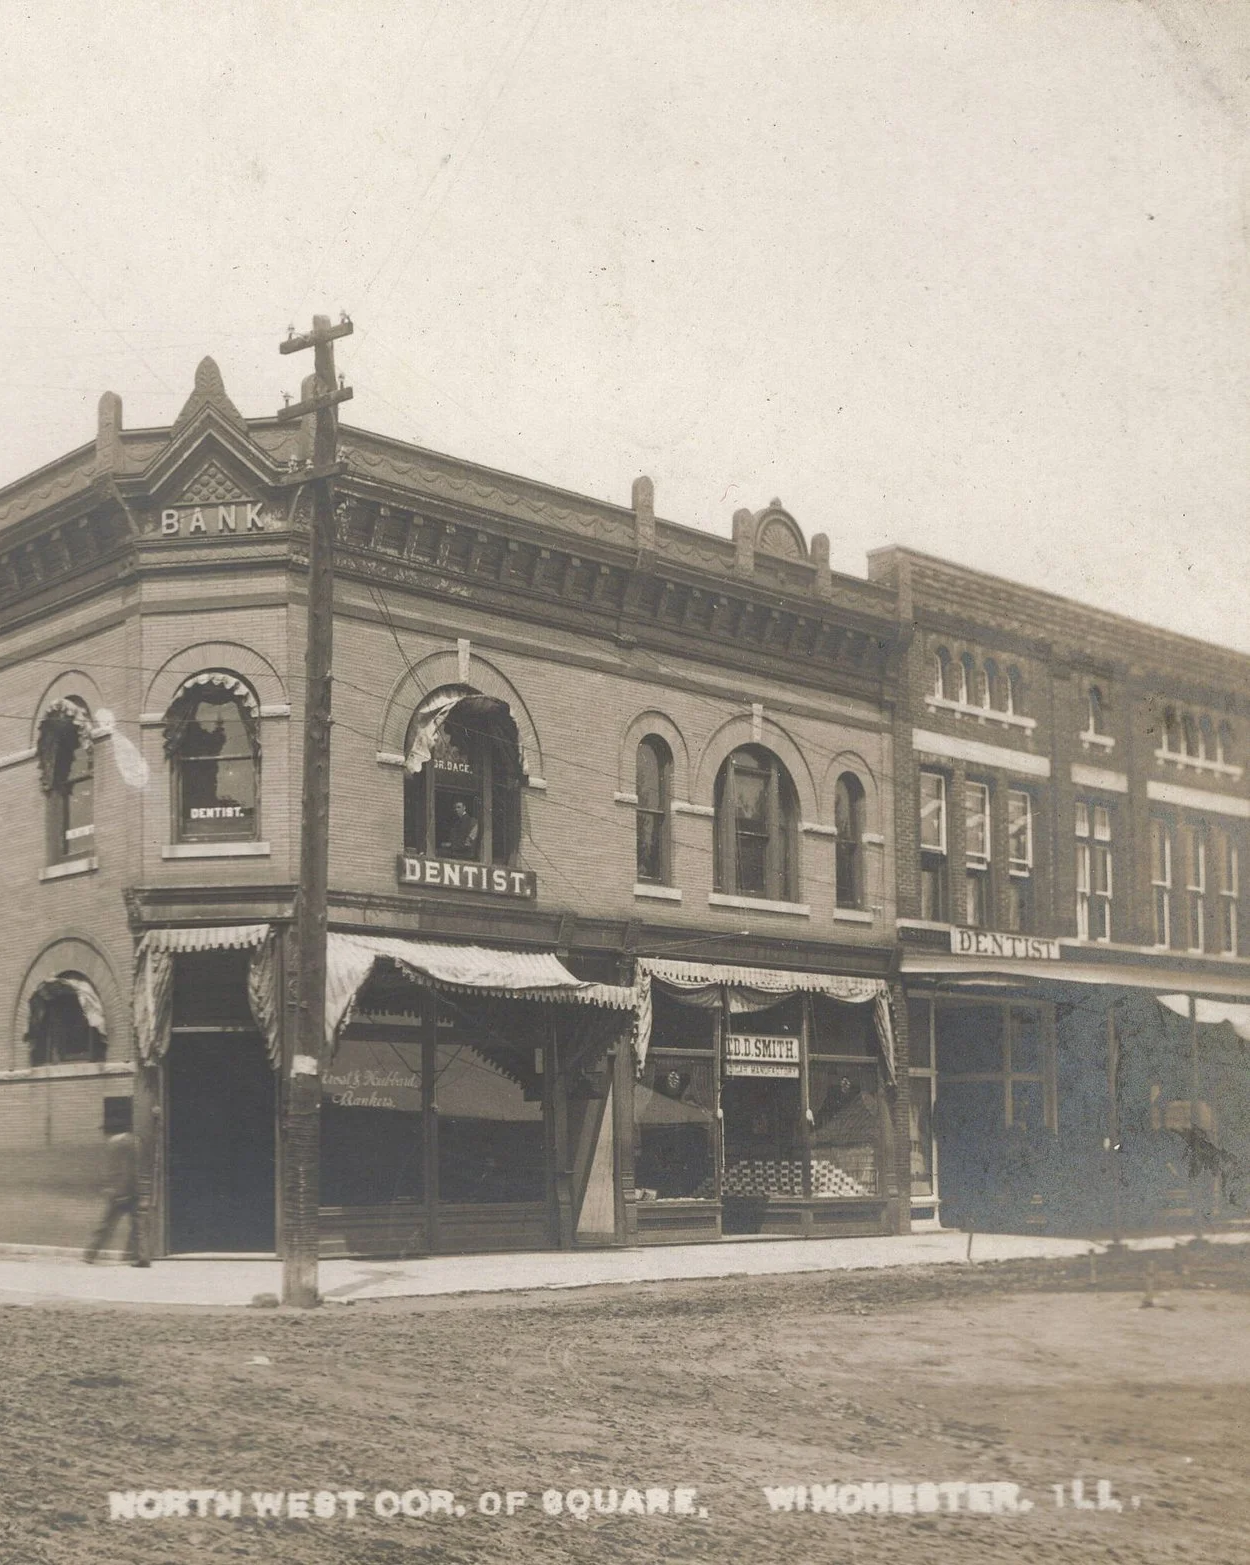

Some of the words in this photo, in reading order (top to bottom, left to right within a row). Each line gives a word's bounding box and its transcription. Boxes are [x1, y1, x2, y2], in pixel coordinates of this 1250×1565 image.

[161, 502, 265, 535] BANK
[190, 806, 245, 819] DENTIST.
[404, 857, 531, 895] DENTIST.
[958, 929, 1056, 959] DENTIST
